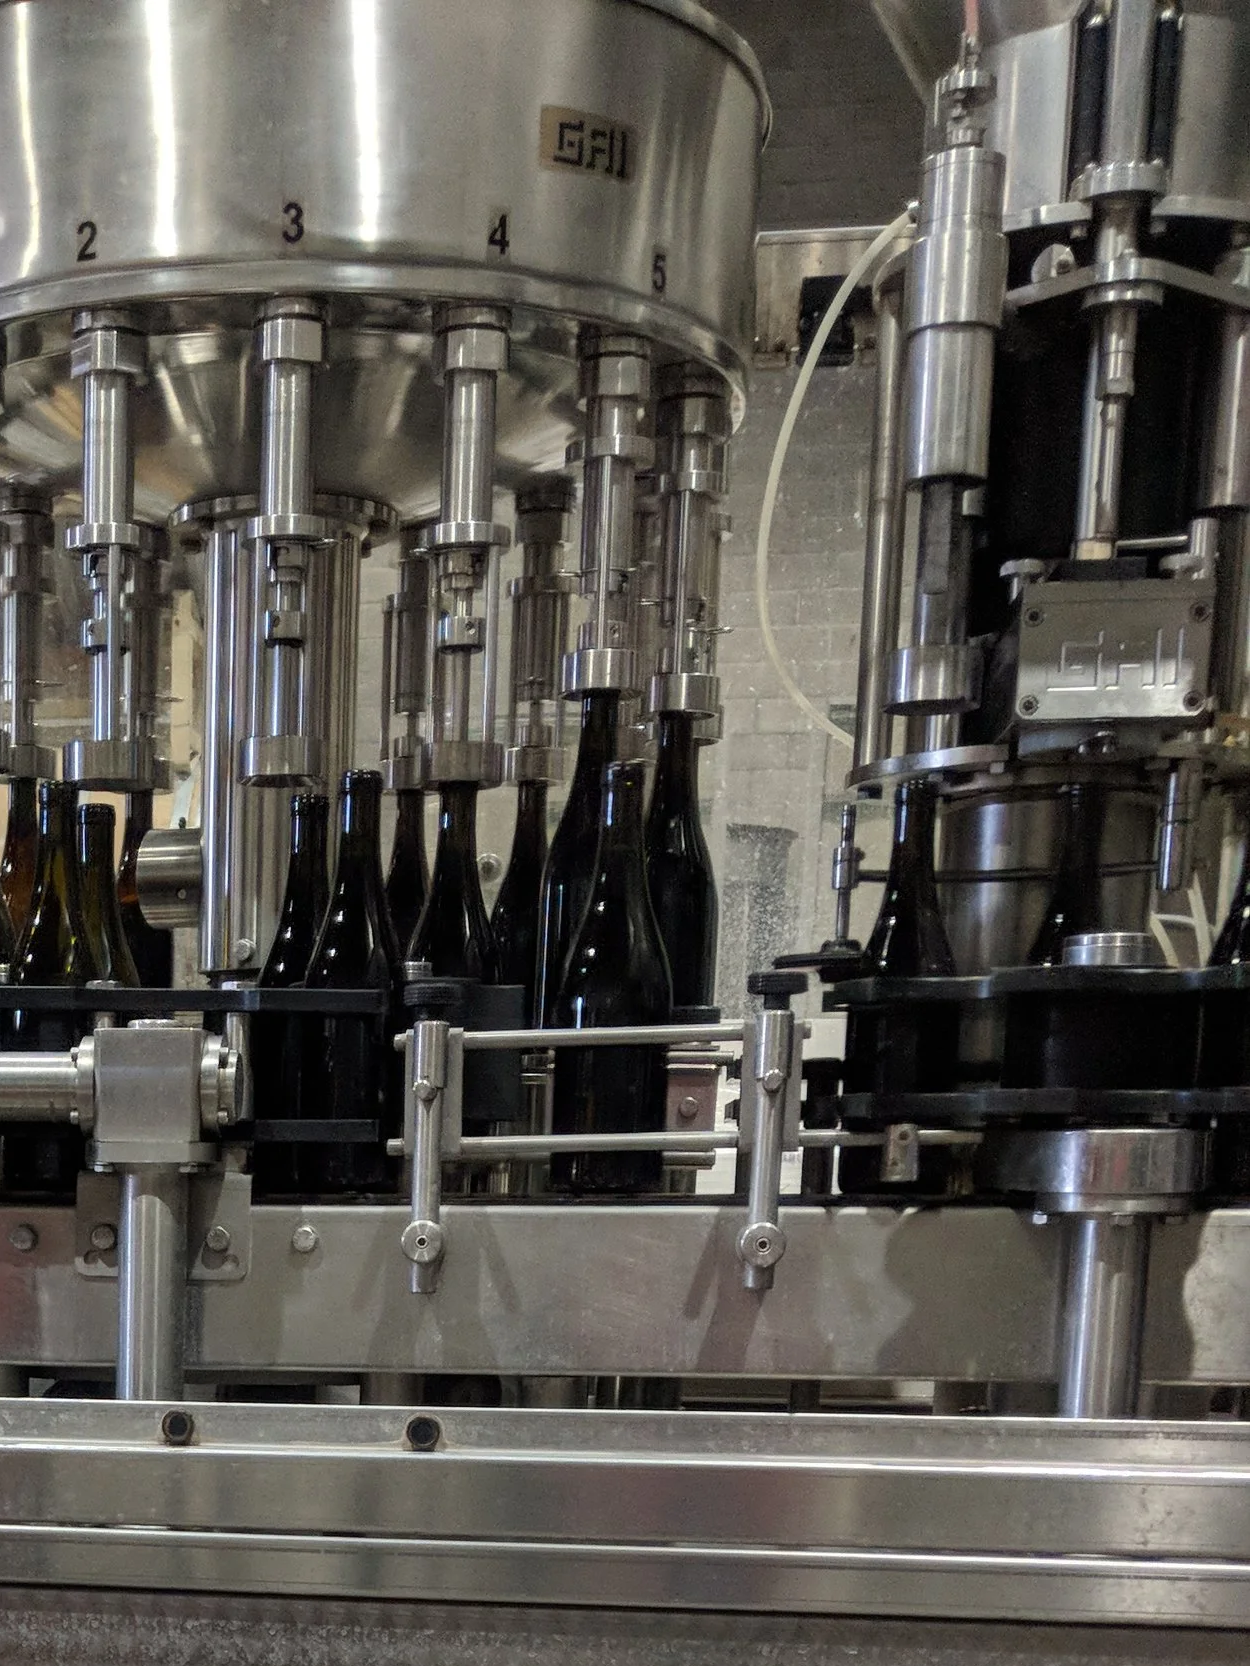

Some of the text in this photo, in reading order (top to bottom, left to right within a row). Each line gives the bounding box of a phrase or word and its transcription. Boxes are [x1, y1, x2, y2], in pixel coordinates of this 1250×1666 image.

[76, 220, 97, 262] 2
[282, 201, 304, 244] 3
[488, 214, 510, 255] 4
[652, 253, 667, 293] 5
